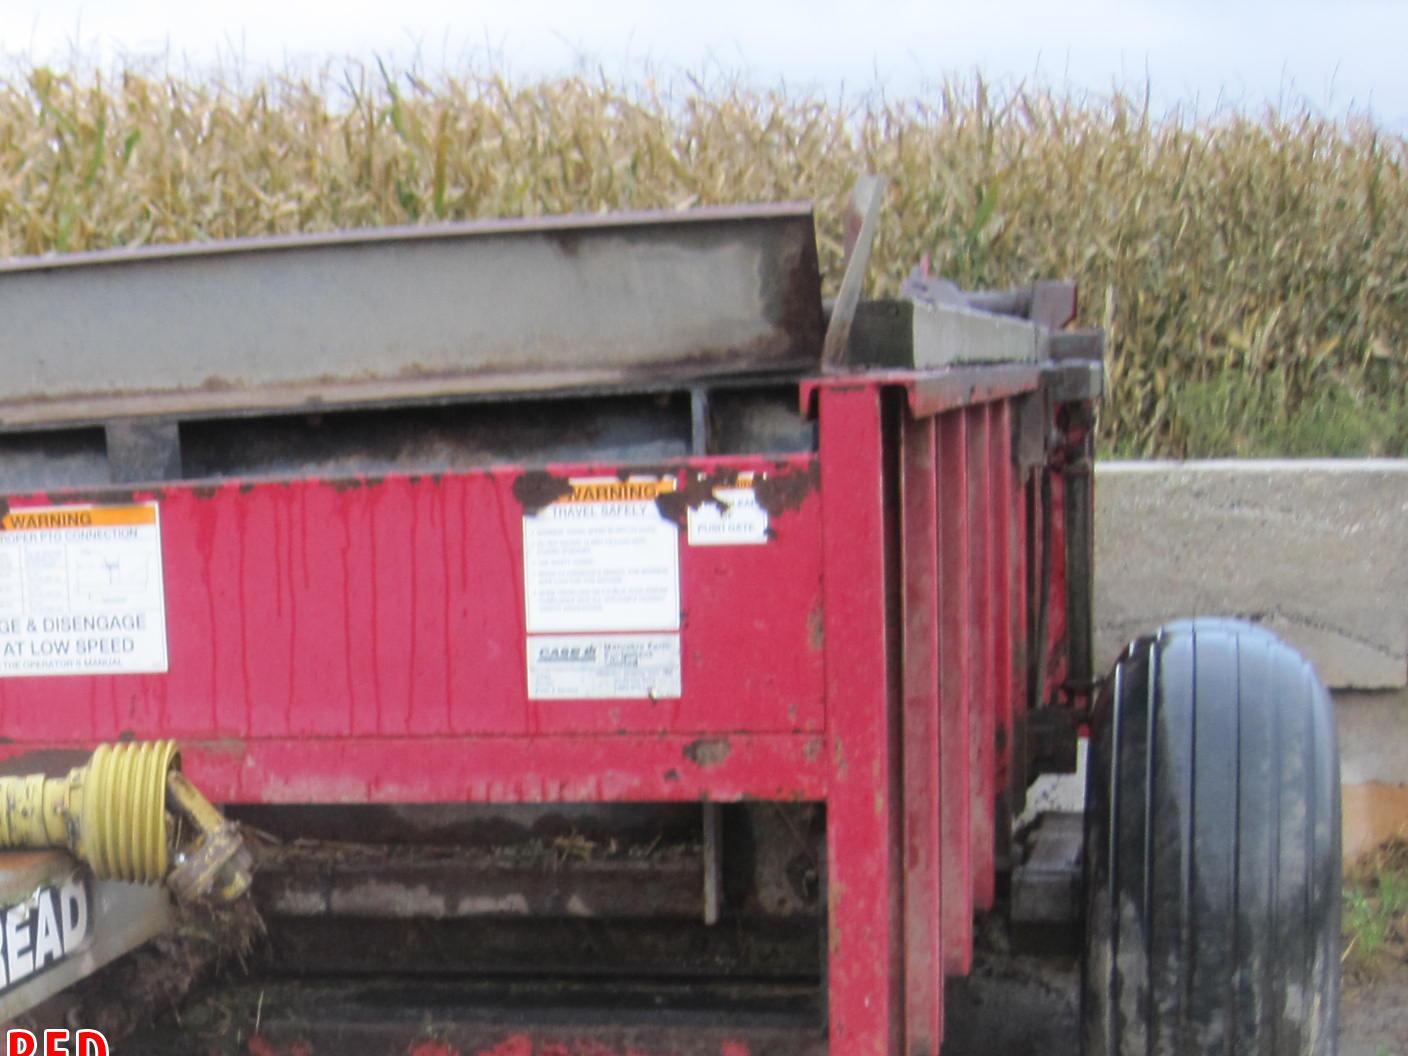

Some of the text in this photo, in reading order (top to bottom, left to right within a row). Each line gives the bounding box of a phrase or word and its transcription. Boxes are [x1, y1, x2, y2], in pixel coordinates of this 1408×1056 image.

[10, 511, 93, 529] WARNING
[65, 527, 139, 542] CONNECTION
[26, 617, 38, 634] &
[43, 614, 146, 633] DISENGAGE
[3, 641, 25, 658] AT
[30, 639, 71, 657] LOW
[75, 636, 136, 655] SPEED
